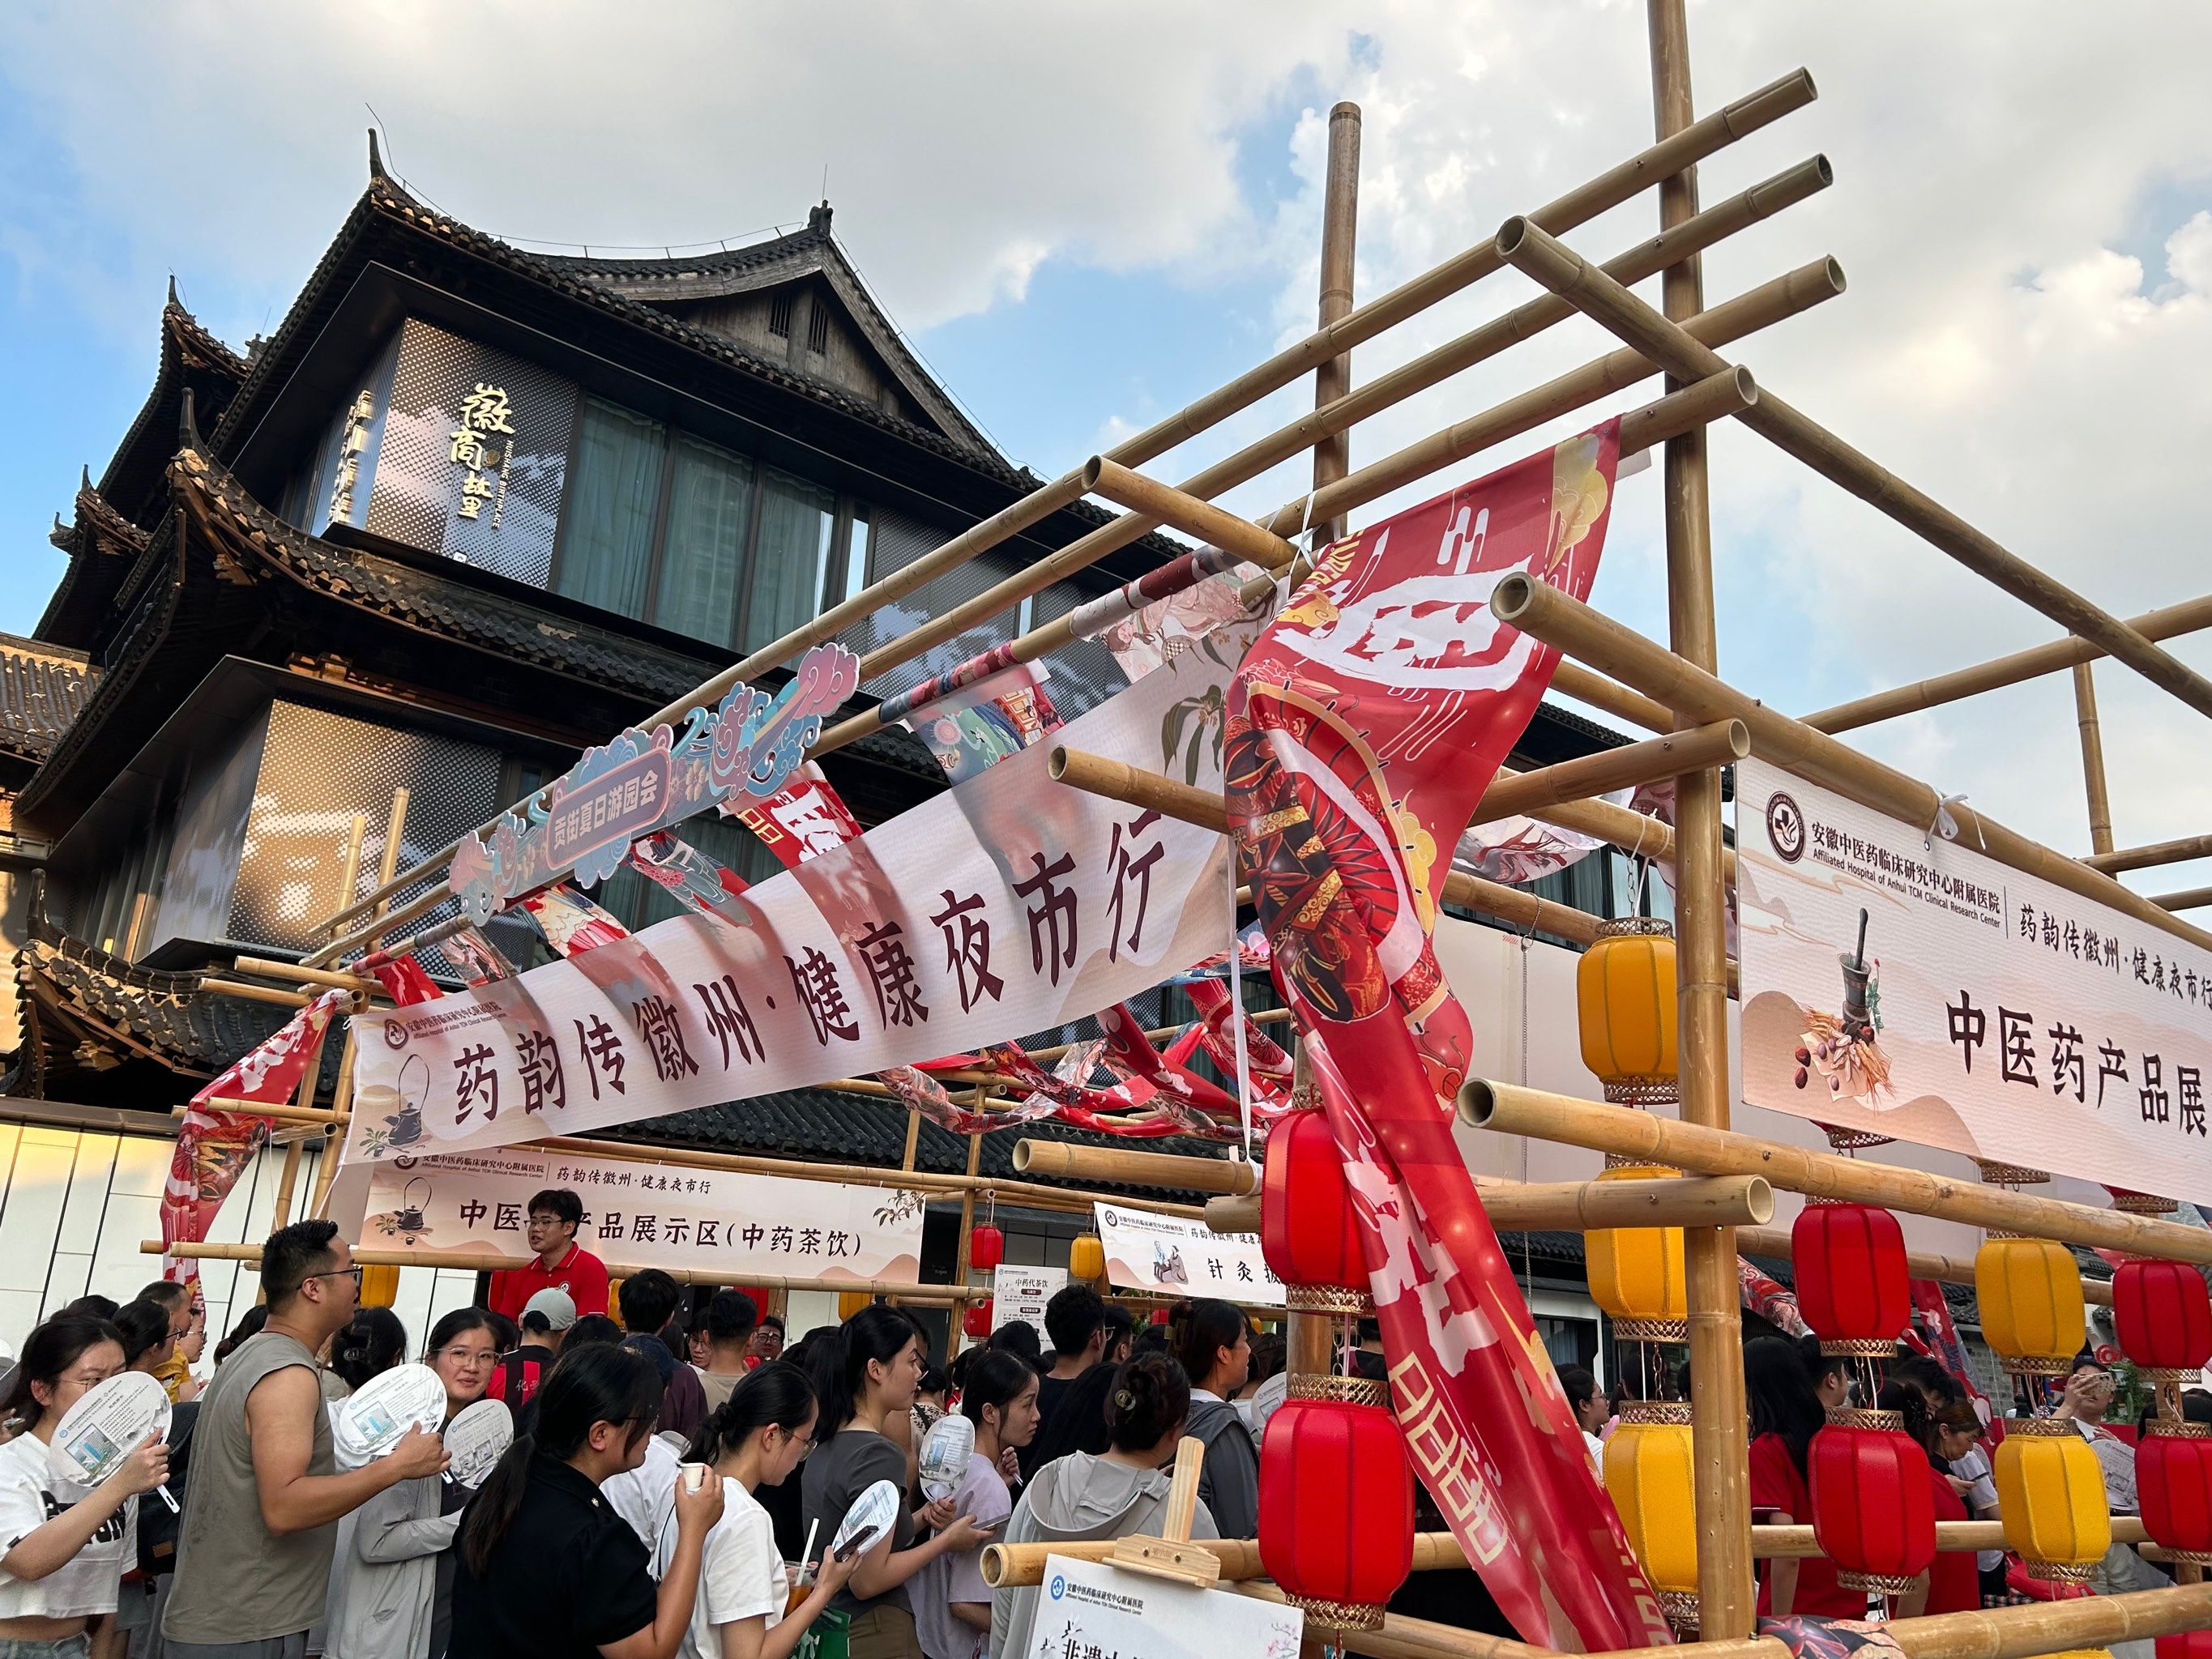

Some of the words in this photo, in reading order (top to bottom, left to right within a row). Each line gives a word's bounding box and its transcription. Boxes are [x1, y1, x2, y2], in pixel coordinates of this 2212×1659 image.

[450, 382, 516, 519] 徽商故里
[502, 439, 515, 480] HUISHANG
[492, 480, 508, 528] BIRTHPLACE
[553, 770, 659, 851] 贡街夏日游园会
[1812, 821, 2001, 915] 安徽中医药临床研究中心附属医院
[1813, 848, 1845, 870] Affiliated
[1847, 861, 1877, 882] Hospital
[1878, 875, 1885, 885] of
[1887, 877, 1907, 894] Anhui
[1908, 885, 1923, 900] TCM
[1924, 893, 1949, 910] Clinical
[1950, 901, 1979, 920] Research
[1980, 913, 2001, 928] Center
[454, 809, 1164, 1125] 药韵传徽州·健康夜市行
[1945, 989, 2207, 1138] 中医药产品展
[556, 1166, 711, 1194] 药韵传徽州·健康夜市行
[459, 1199, 861, 1256] 中医品展示区(中药茶饮)
